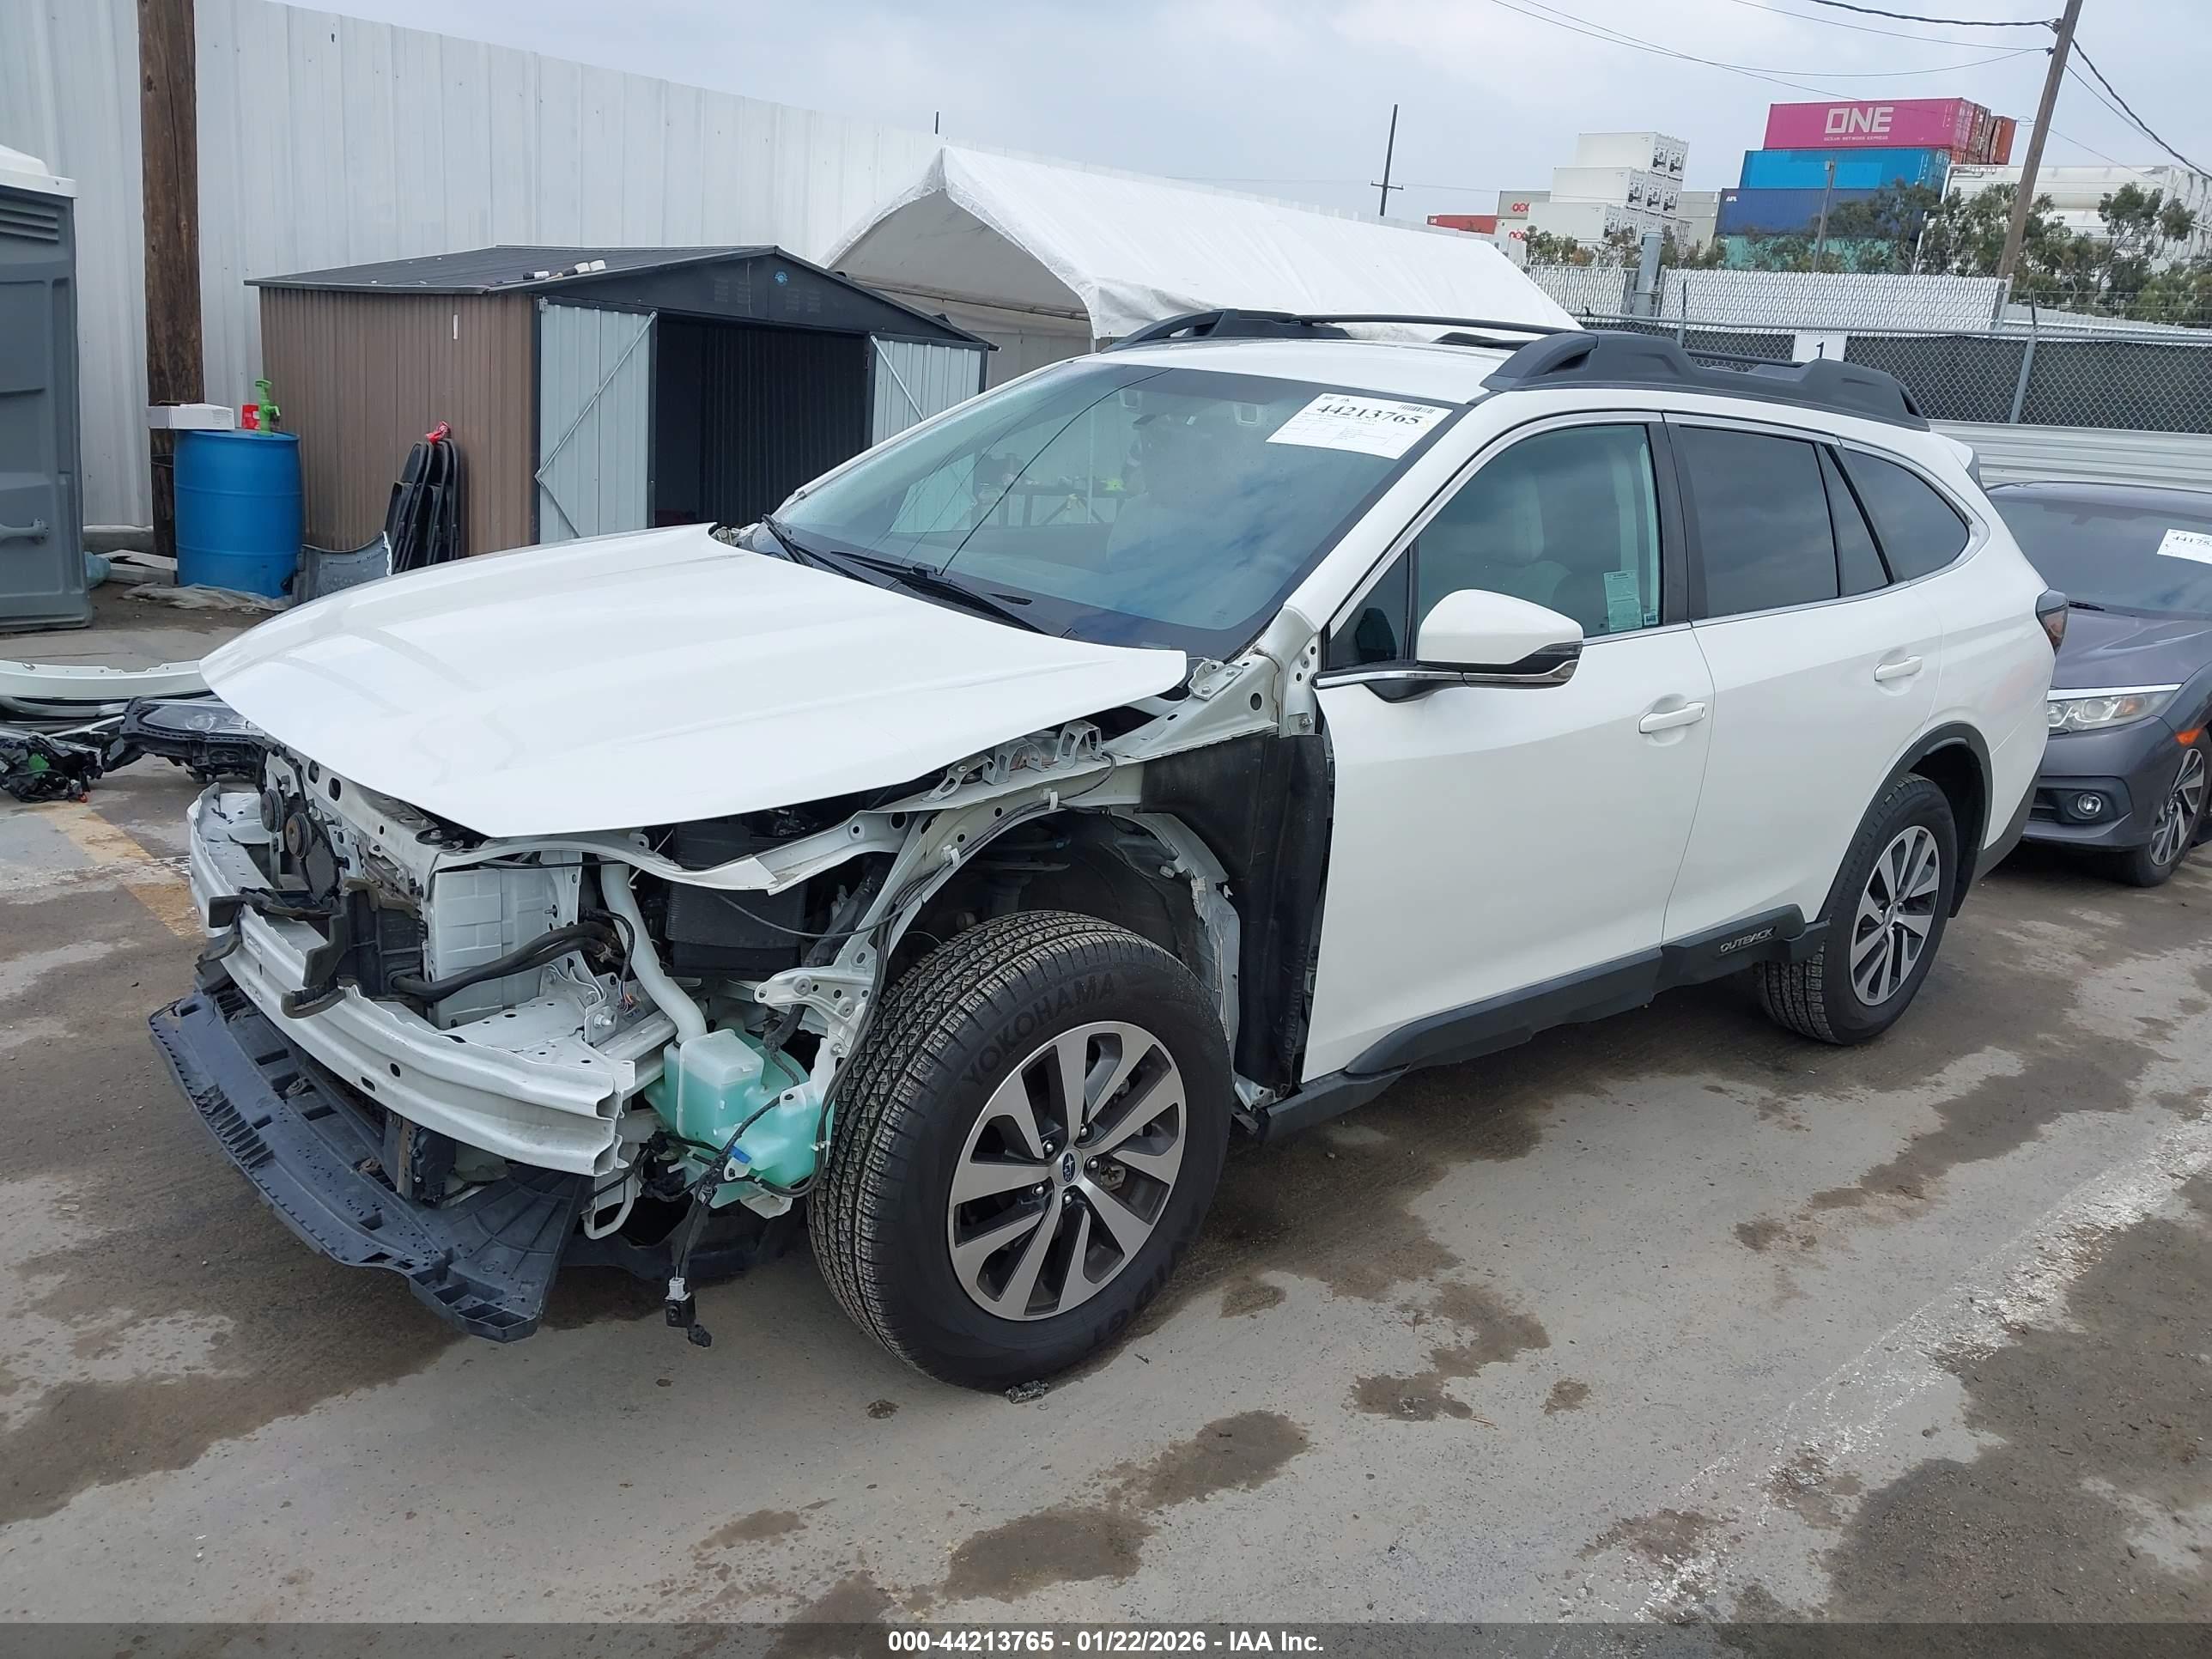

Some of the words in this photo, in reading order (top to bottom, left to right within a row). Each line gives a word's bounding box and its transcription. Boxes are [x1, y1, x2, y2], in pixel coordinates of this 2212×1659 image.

[1825, 106, 1894, 134] ONE
[1816, 341, 1825, 358] 1
[1316, 404, 1424, 425] 44213765
[1720, 927, 1774, 952] OUTBACK
[960, 972, 1116, 1087] YOKOHAMA
